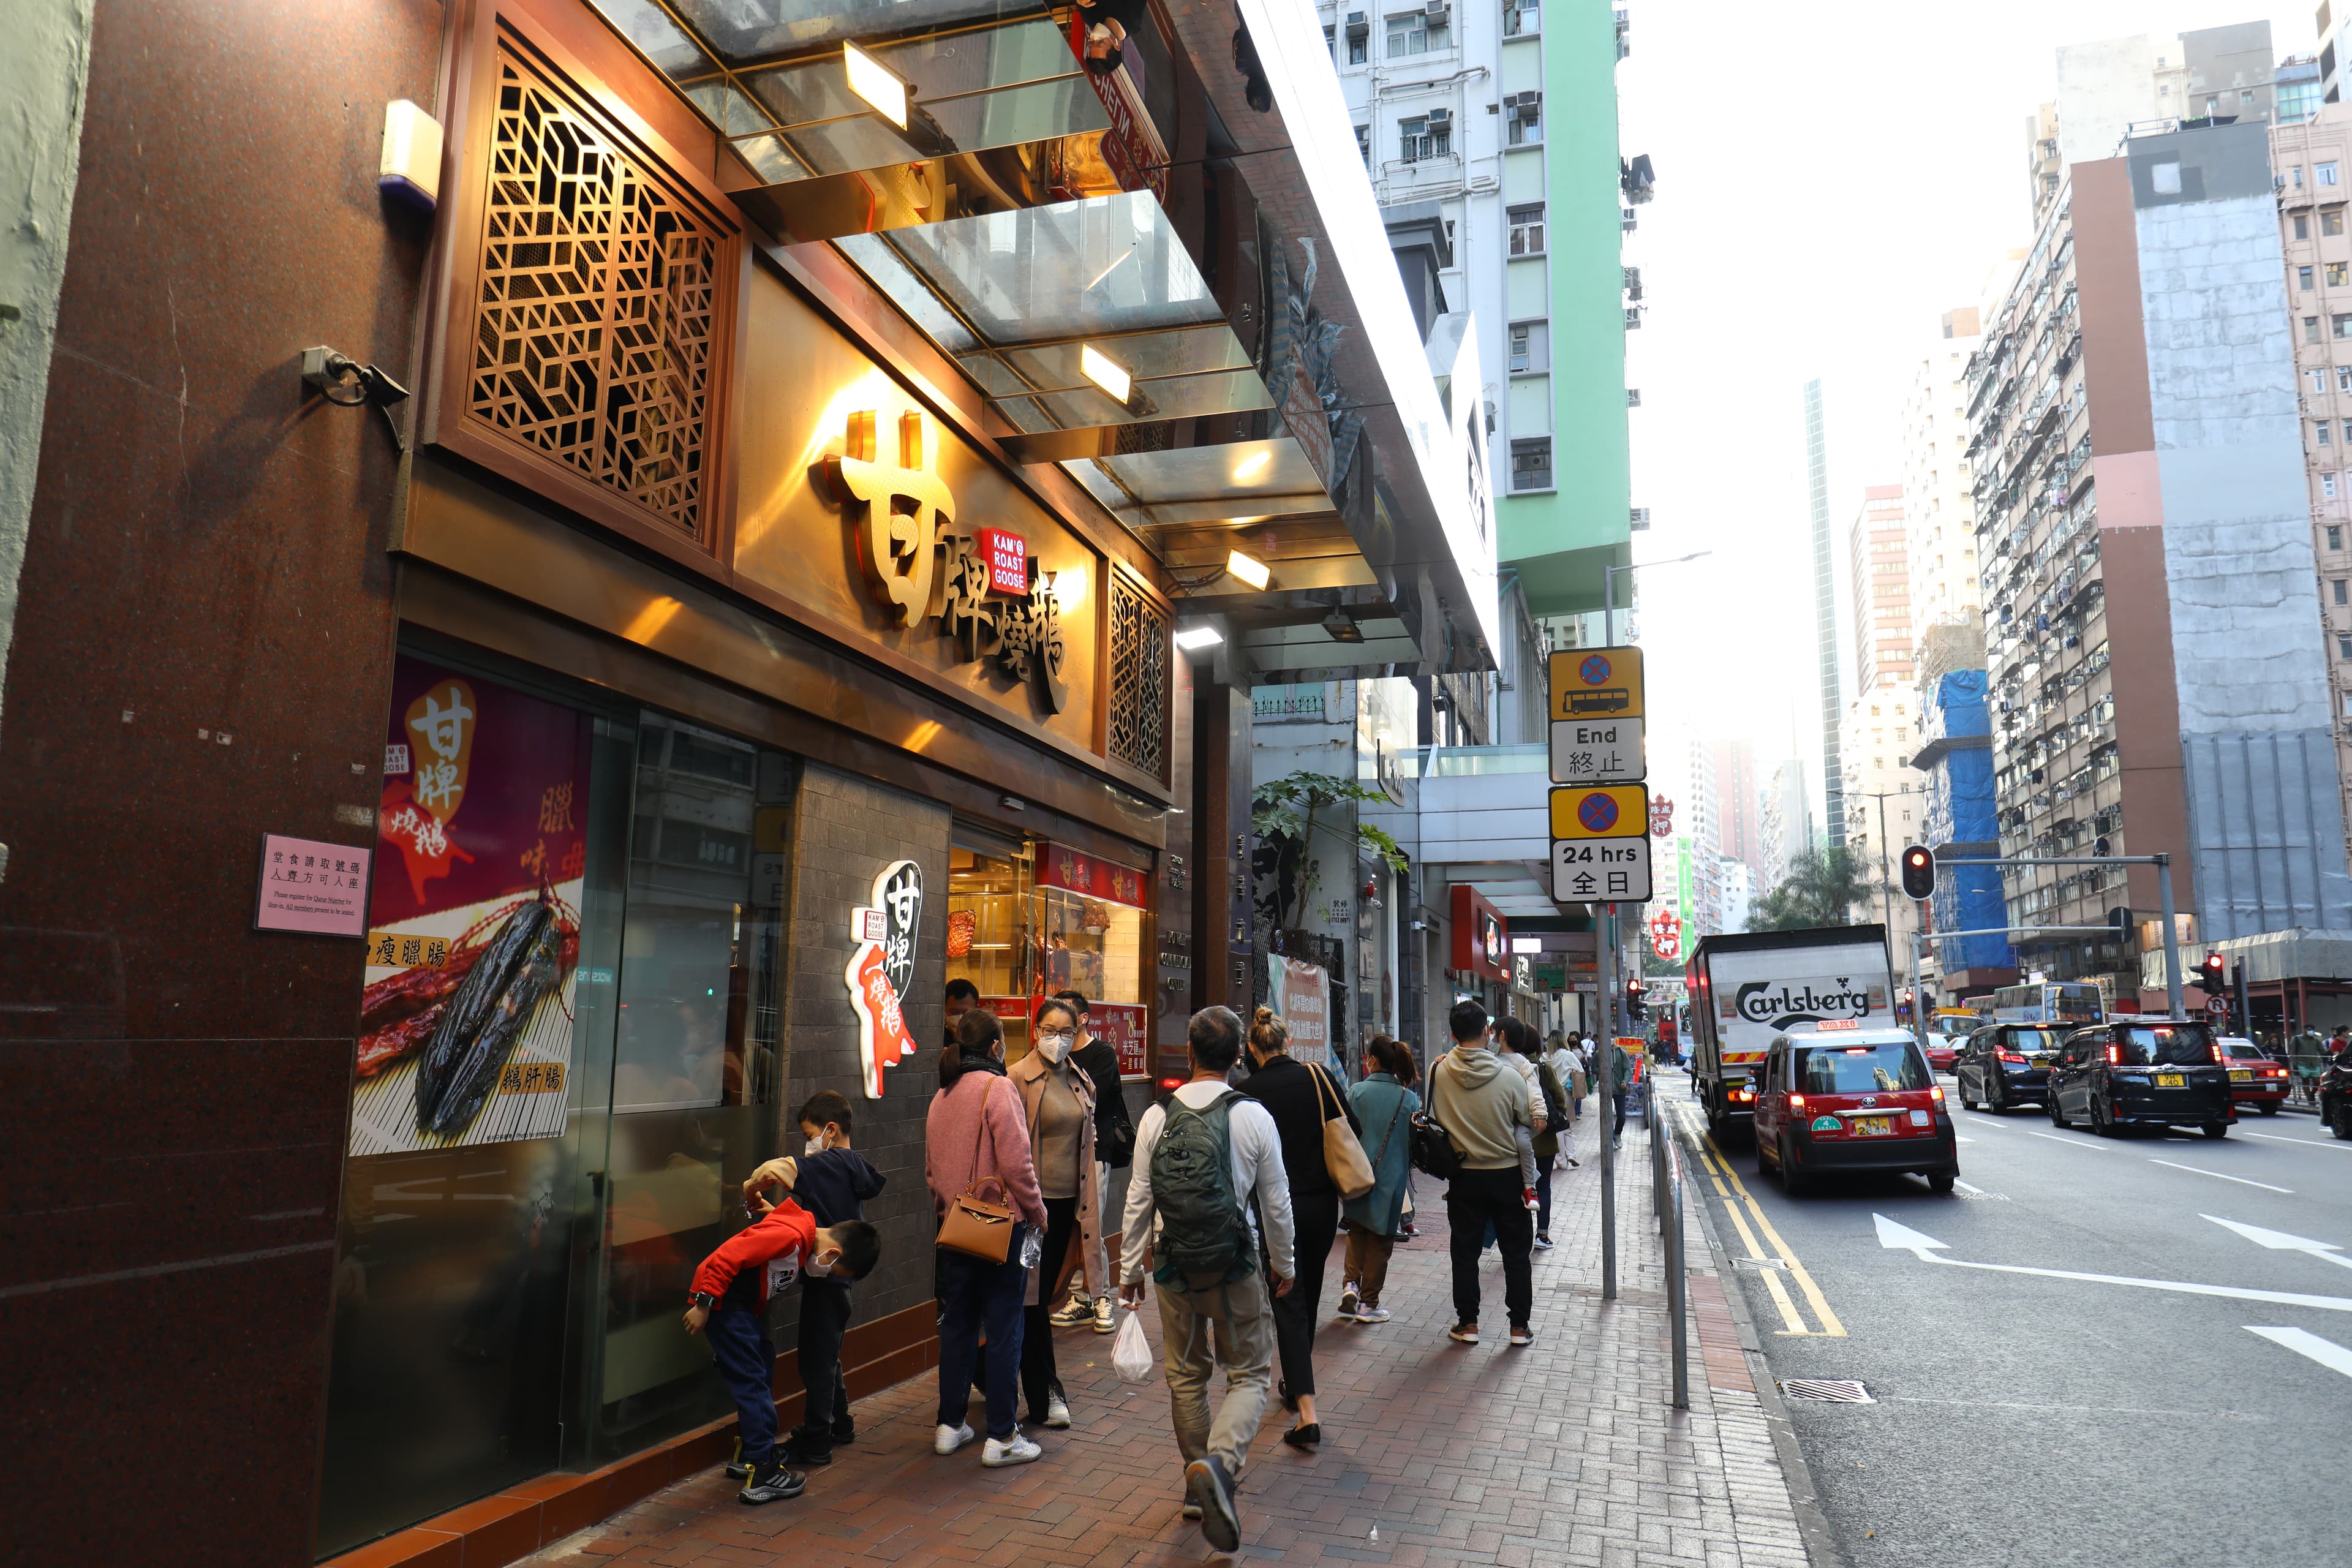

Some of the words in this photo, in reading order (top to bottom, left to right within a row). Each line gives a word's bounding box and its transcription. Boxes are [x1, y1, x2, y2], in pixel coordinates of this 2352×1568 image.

[993, 533, 1023, 556] KAM'S
[994, 551, 1023, 572] ROAST
[995, 568, 1024, 589] GOOSE
[1577, 727, 1617, 744] End
[410, 687, 473, 809] 甘牌
[1569, 750, 1625, 774] 終止
[391, 808, 447, 857] 燒鵝
[273, 851, 360, 874] 堂食請取號碼
[1563, 847, 1593, 864] 24
[1602, 846, 1637, 862] hrs
[1572, 871, 1629, 895] 全日
[868, 914, 885, 922] KAM'S
[886, 869, 920, 984] 甘牌
[366, 935, 447, 968] 瘦臘腸
[870, 974, 902, 1038] 燒鵝
[1736, 981, 1870, 1022] Carlsberg
[503, 1065, 564, 1090] 鵝肝腸
[1858, 1126, 1888, 1136] 2840
[1865, 1118, 1879, 1127] XJ
